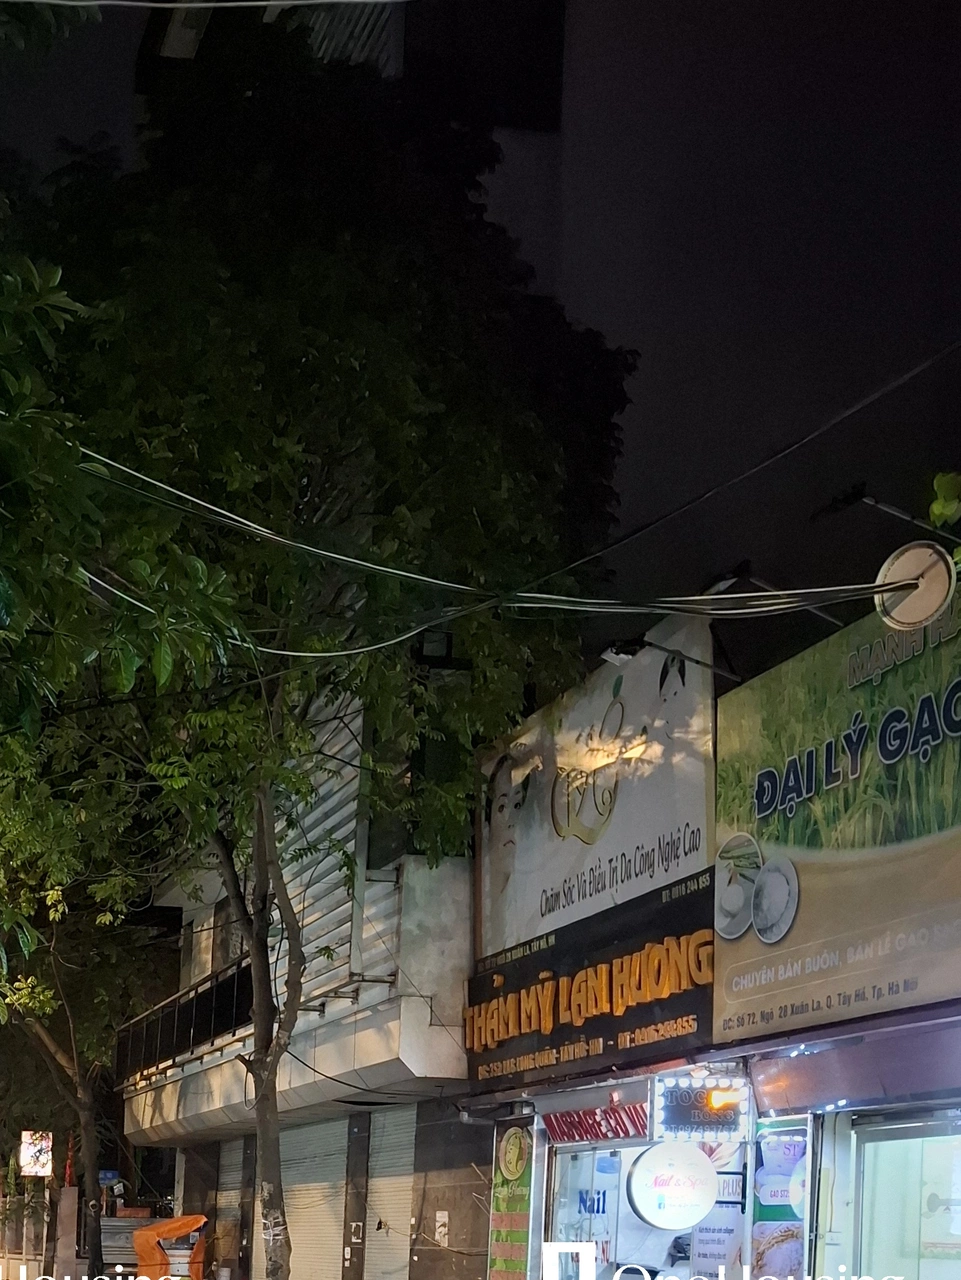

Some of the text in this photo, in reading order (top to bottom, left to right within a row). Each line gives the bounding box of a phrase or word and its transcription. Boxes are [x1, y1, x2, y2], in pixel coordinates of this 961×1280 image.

[754, 747, 816, 818] ĐẠI
[823, 710, 869, 790] LÝ
[562, 876, 575, 910] Sóc
[576, 872, 587, 902] Và
[588, 857, 606, 898] Điều
[607, 854, 619, 893] Trị
[620, 852, 632, 884] Da
[633, 843, 656, 879] Công
[657, 829, 681, 873] Nghệ
[683, 822, 701, 857] Cao
[520, 970, 557, 1035] MỸ
[558, 963, 611, 1027] LAN
[612, 928, 715, 1017] HƯƠNG
[732, 966, 775, 993] CHUYÊN
[778, 958, 802, 982] BÁN
[846, 942, 874, 964] BÁN
[736, 1012, 746, 1028] Số
[760, 1007, 775, 1025] Ngõ
[778, 1005, 788, 1019] 28
[790, 1001, 809, 1016] Xuân
[826, 995, 835, 1010] Q.
[837, 991, 852, 1009] Tây
[872, 984, 885, 1000] Tp.
[888, 980, 901, 995] Hà
[578, 1189, 607, 1215] Nail
[646, 1174, 672, 1188] Nail
